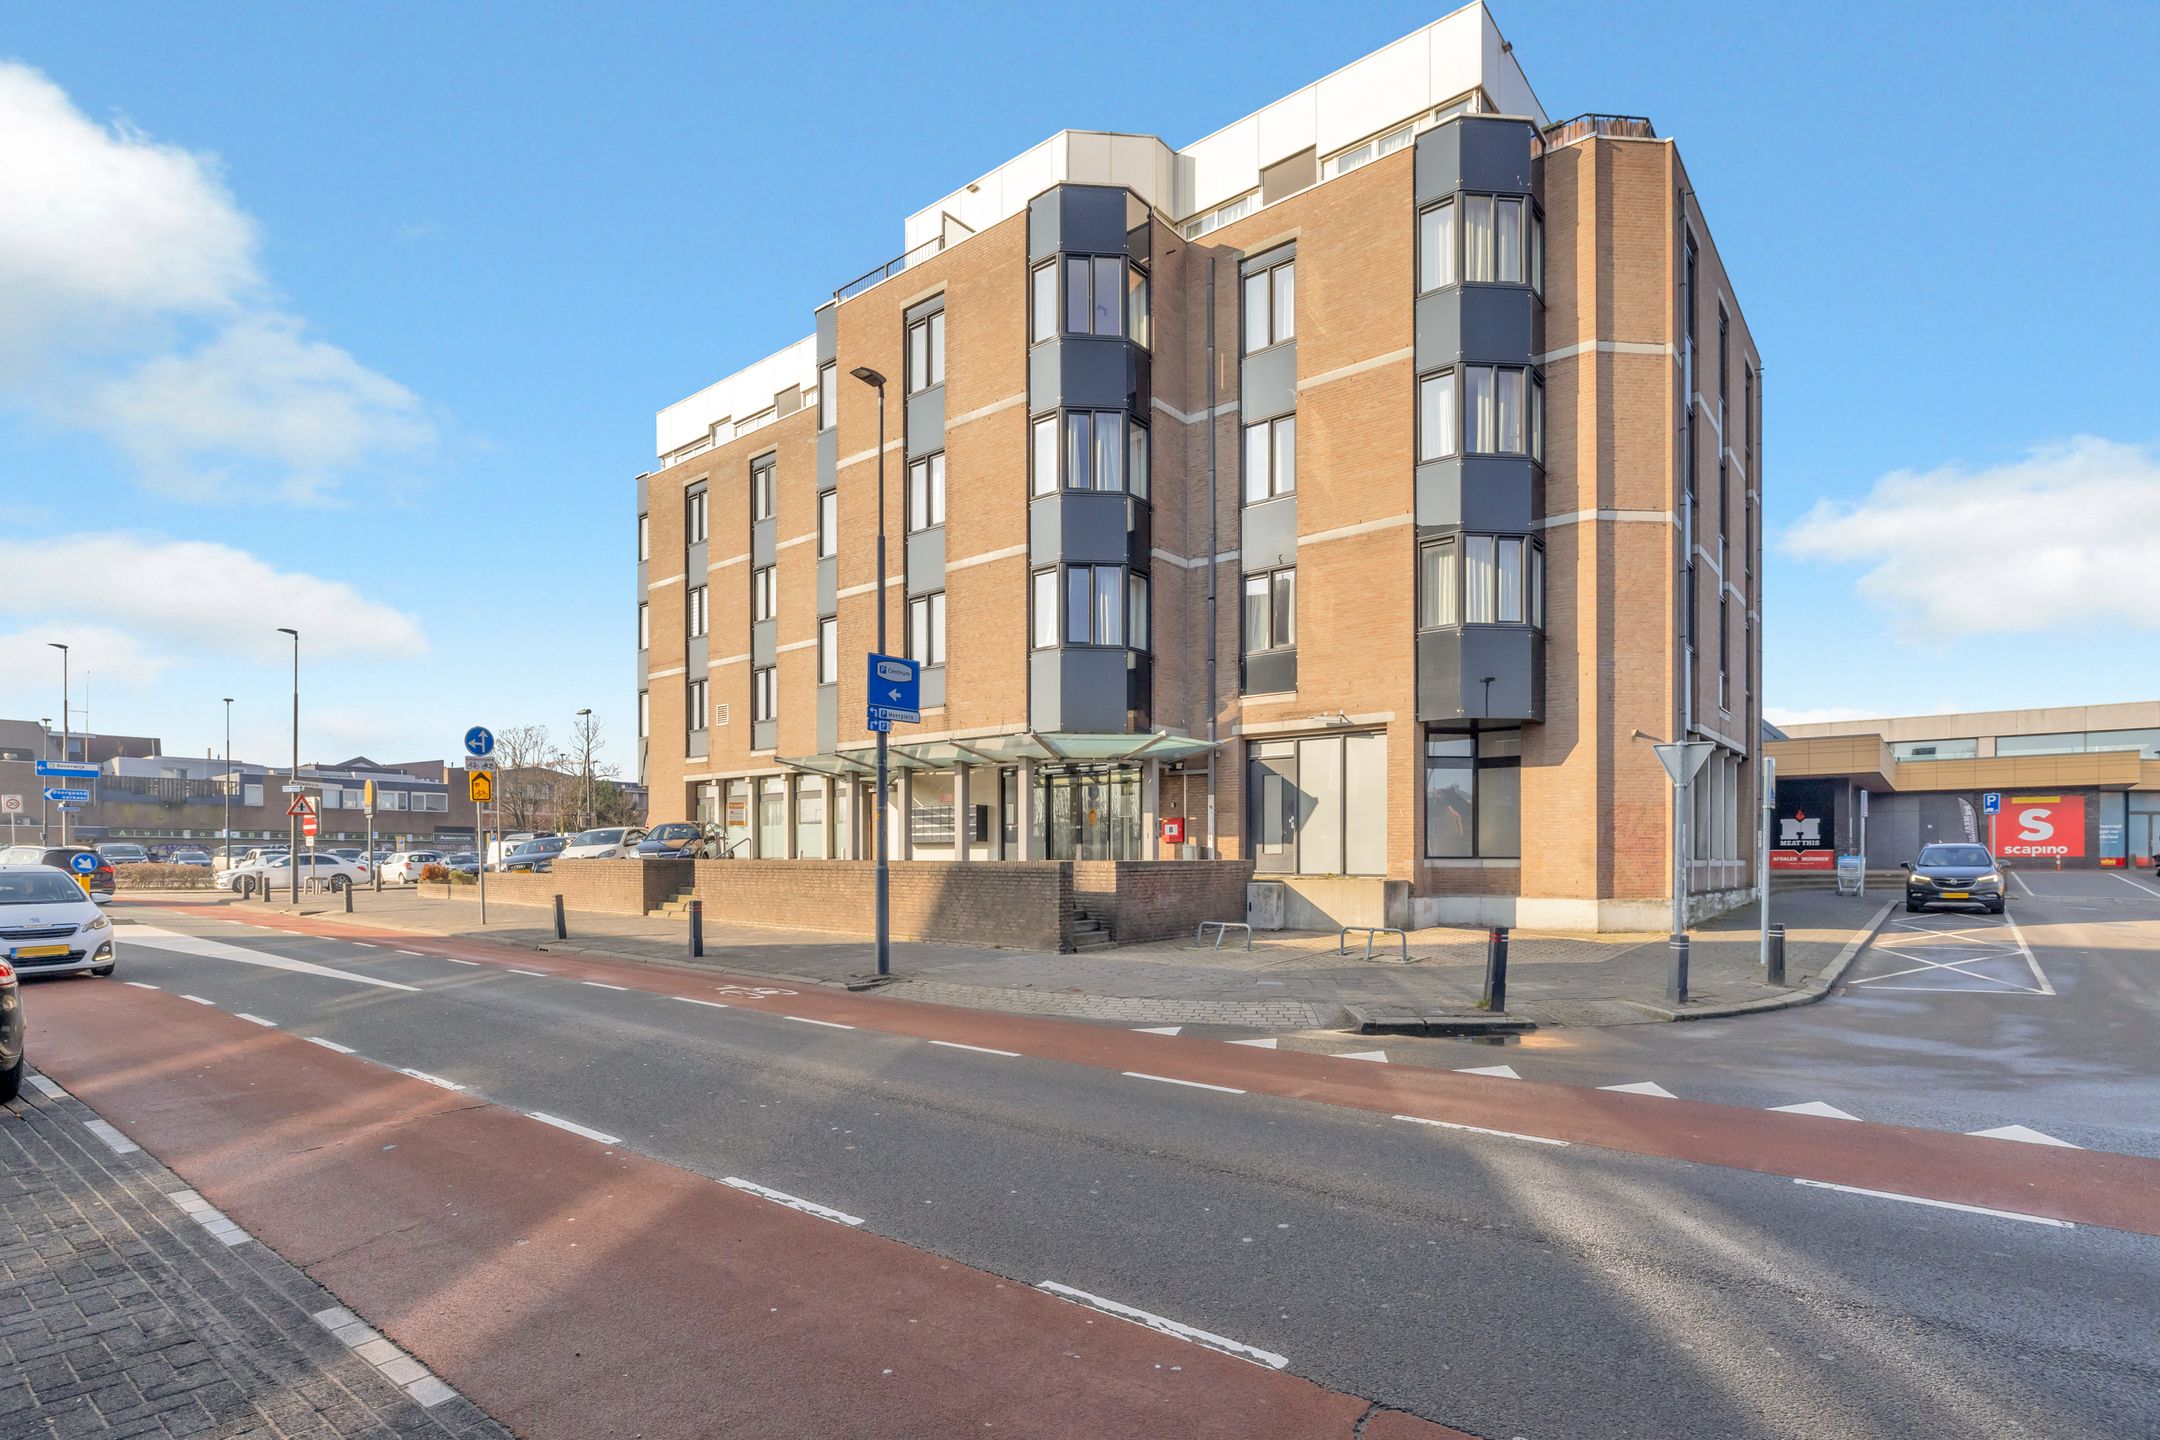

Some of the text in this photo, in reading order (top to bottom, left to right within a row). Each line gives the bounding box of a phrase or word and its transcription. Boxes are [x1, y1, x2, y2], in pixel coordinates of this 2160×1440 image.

[888, 668, 911, 676] Centrum
[2018, 808, 2054, 841] S
[2004, 845, 2069, 857] scapino
